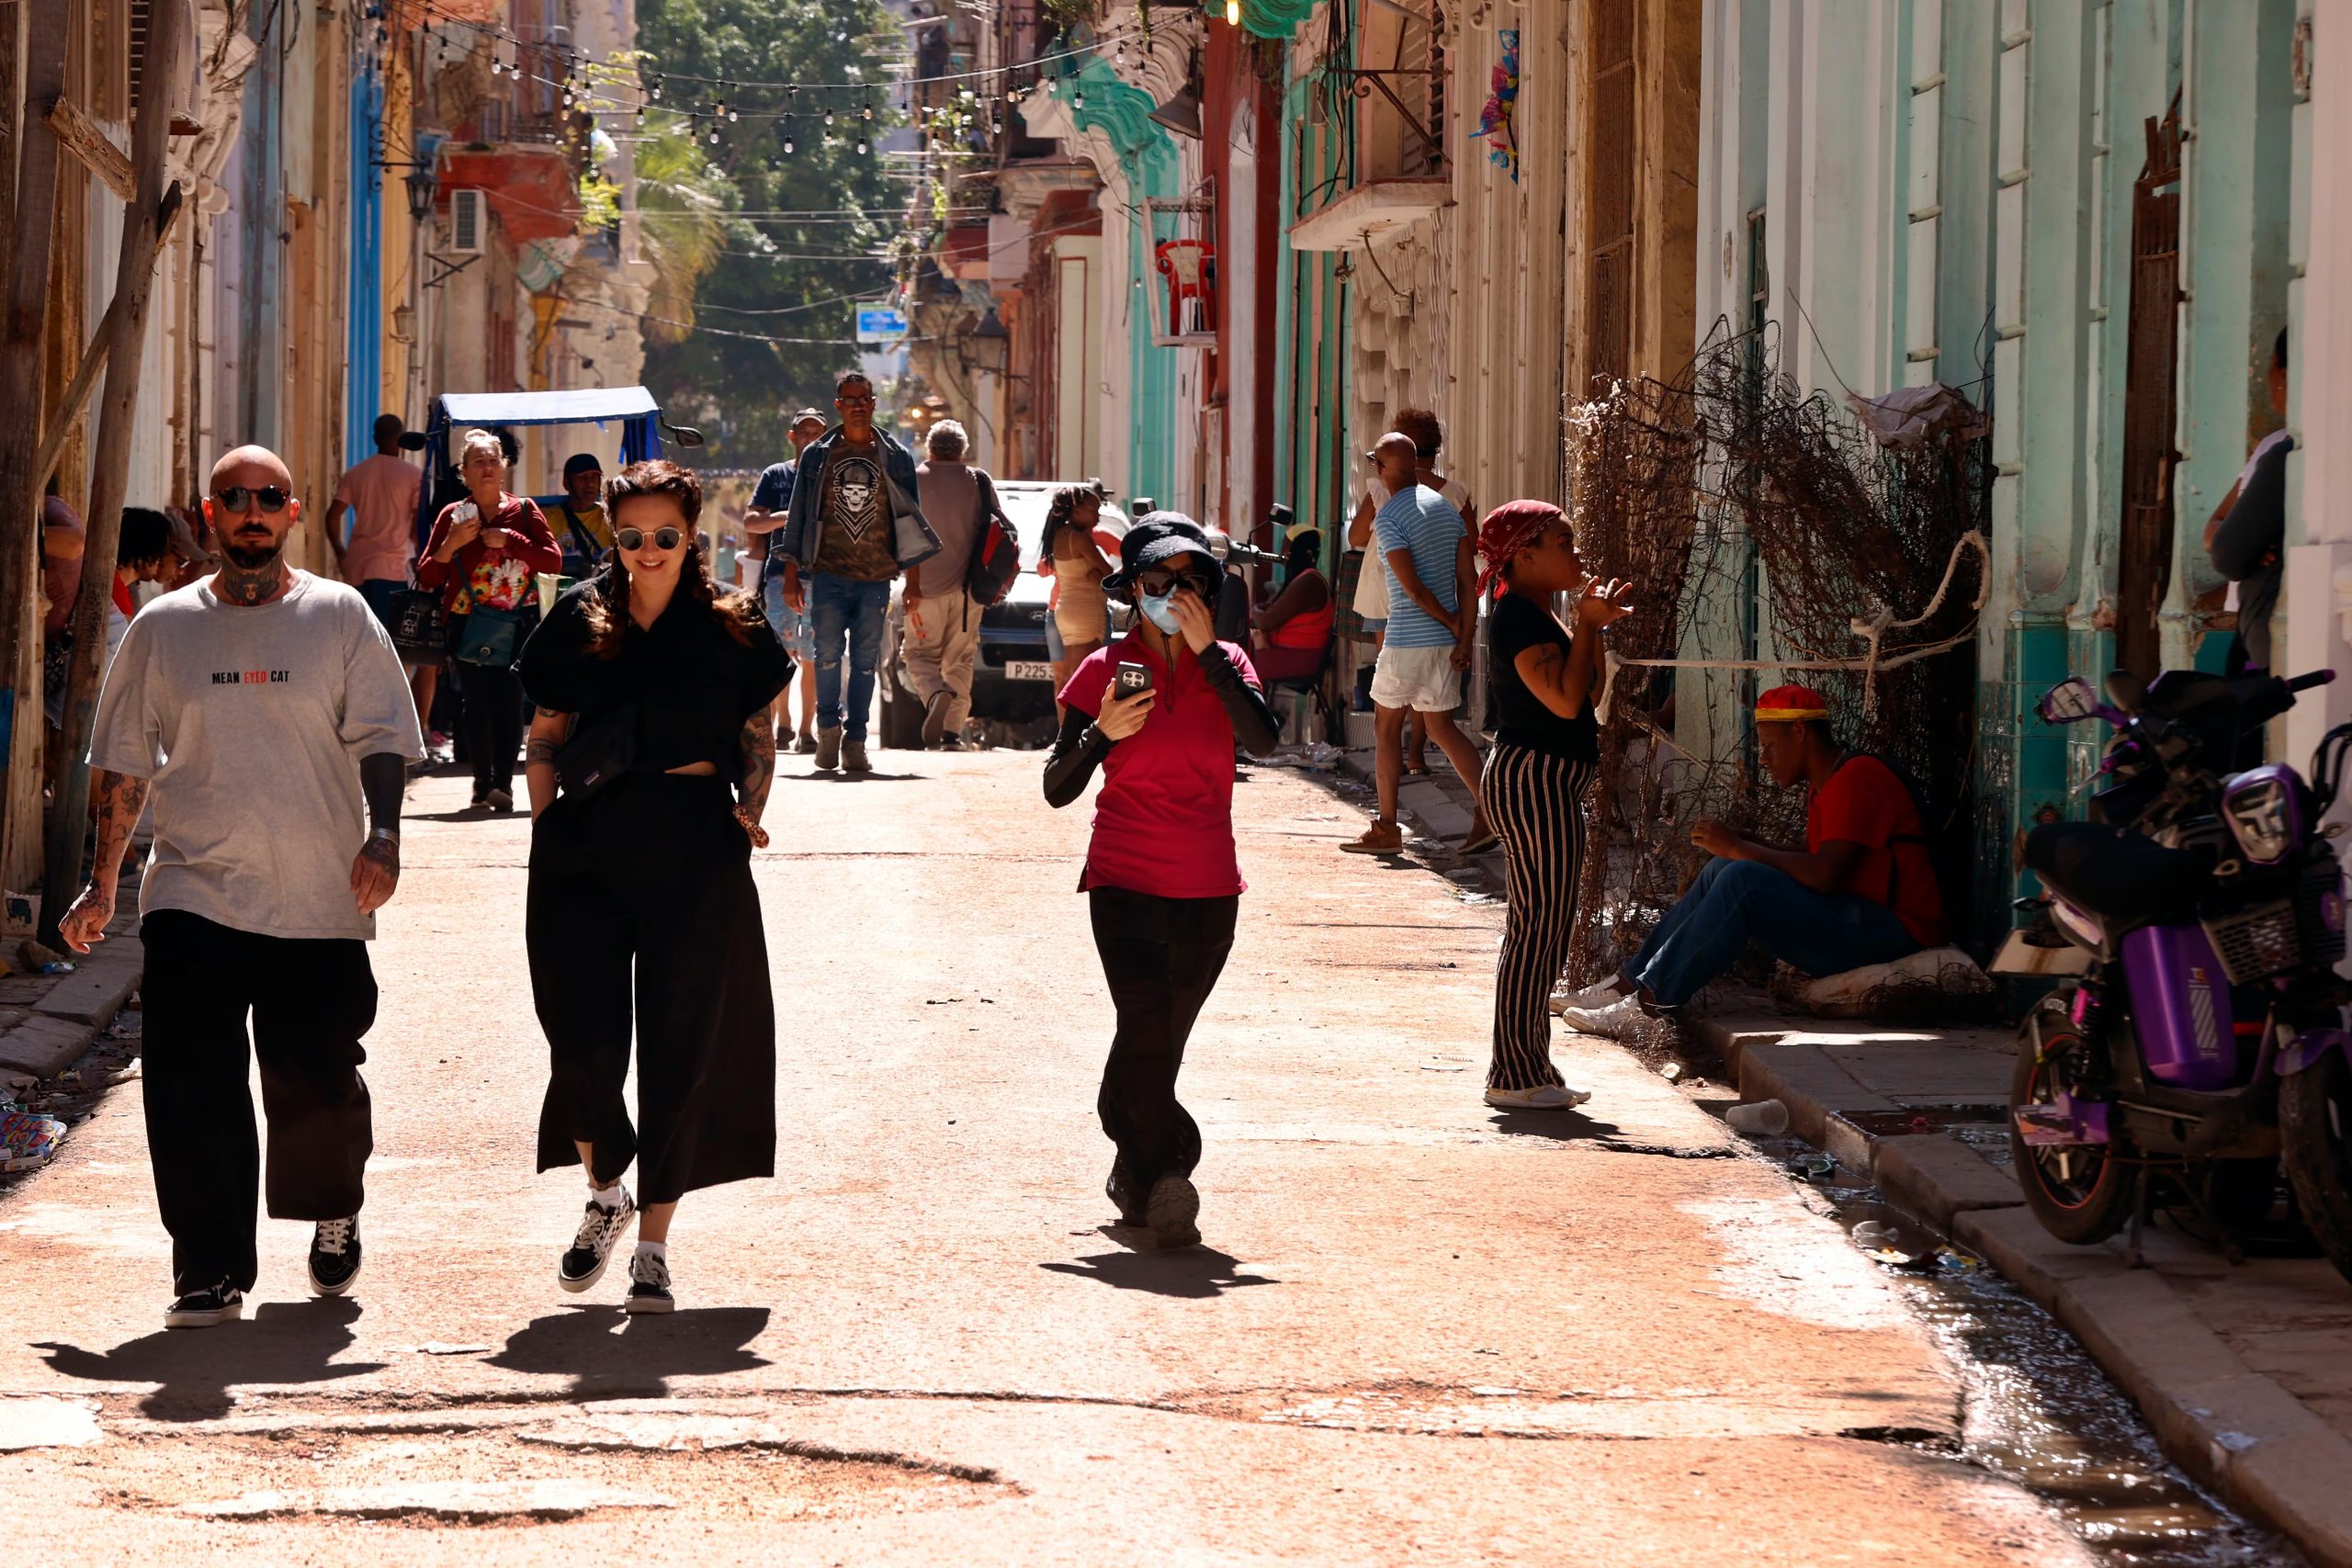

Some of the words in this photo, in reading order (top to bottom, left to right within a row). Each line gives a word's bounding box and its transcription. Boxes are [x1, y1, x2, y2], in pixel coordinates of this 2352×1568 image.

[211, 671, 240, 684] MEAN
[243, 671, 266, 683] EYED
[270, 671, 290, 682] CAT
